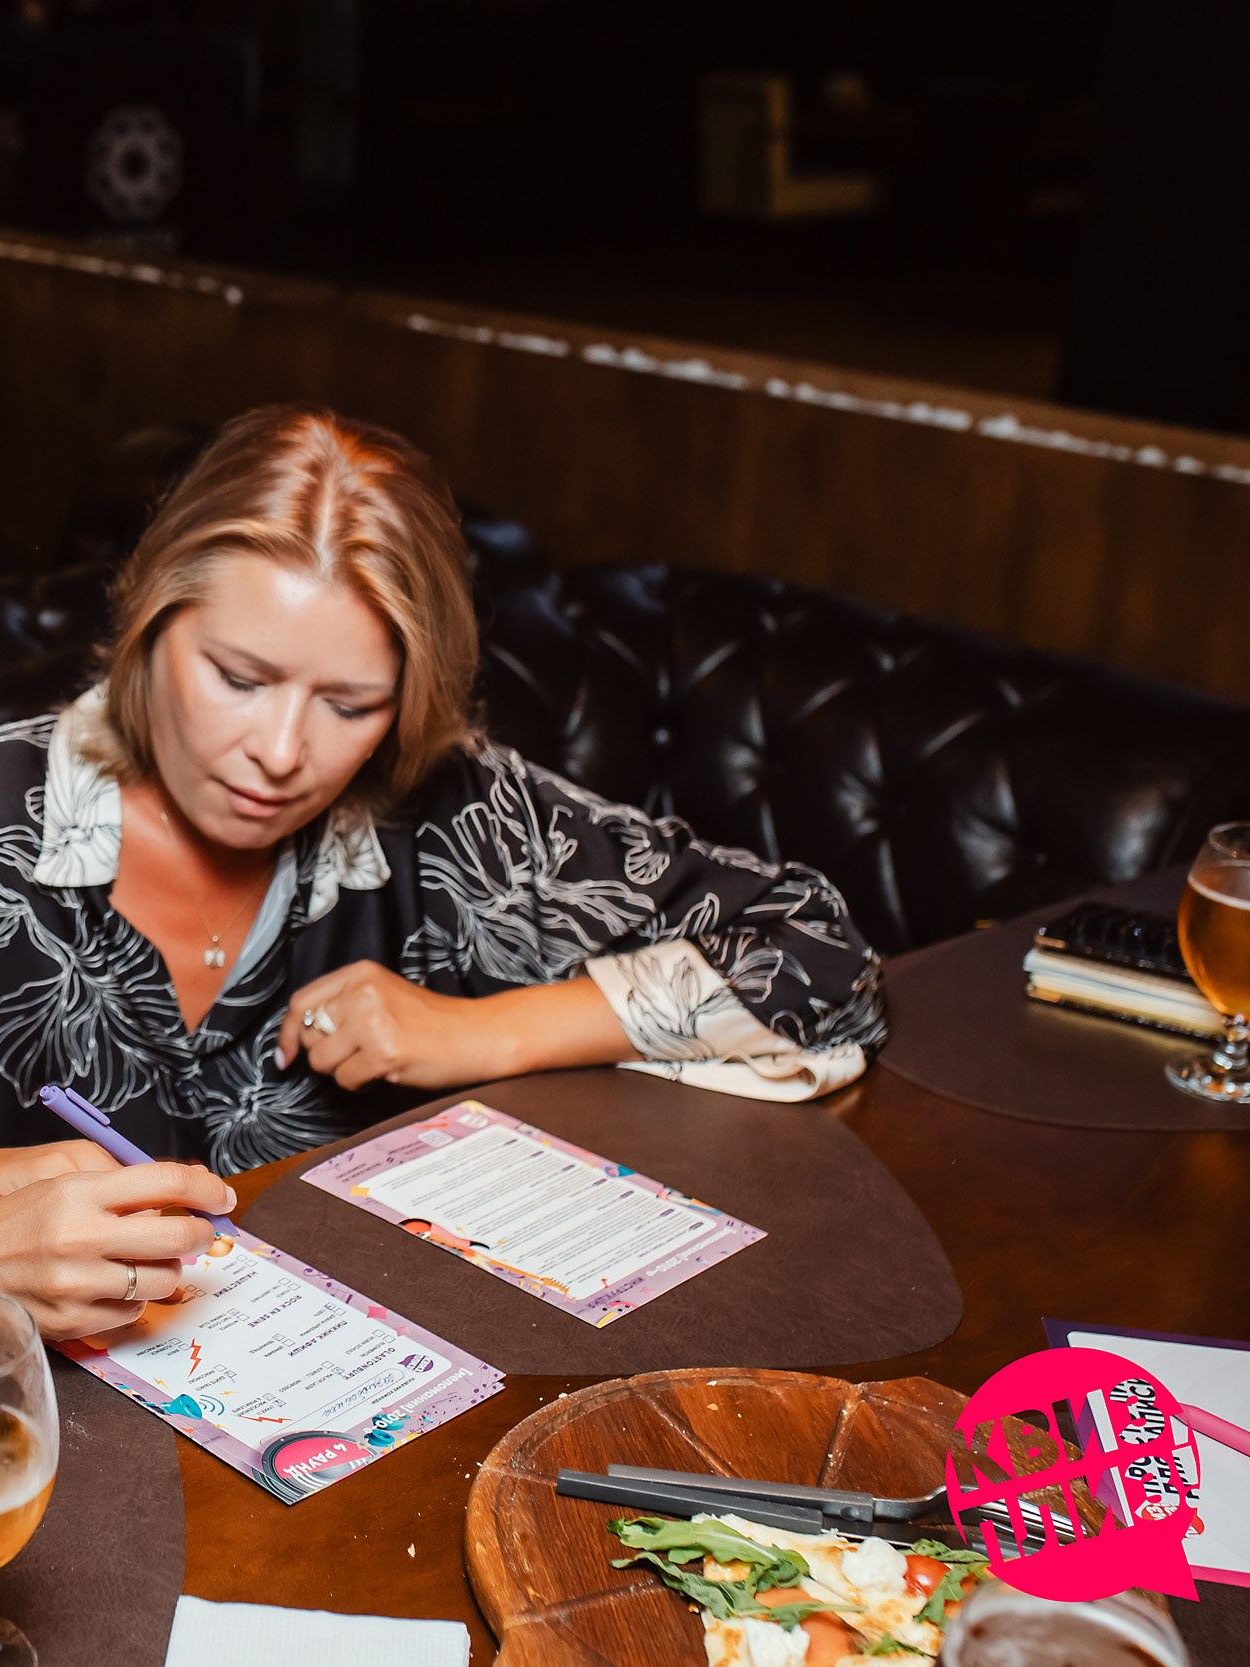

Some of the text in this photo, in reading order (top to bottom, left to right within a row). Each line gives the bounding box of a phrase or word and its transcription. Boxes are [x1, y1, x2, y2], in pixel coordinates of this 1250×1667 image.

[213, 1271, 257, 1297] НАШЕСТВИЕ
[588, 1277, 643, 1308] ИНСТРУКЦИЯ
[248, 1295, 302, 1327] ROCK EN SEINE
[288, 1321, 347, 1356] ПИКНИК АФИШИ
[344, 1348, 395, 1380] GLASTONBURY
[304, 1373, 333, 1391] MAJOR LAZER
[362, 1367, 474, 1434] [меломания] 2010-е
[283, 1442, 348, 1478] 4 РАУНД
